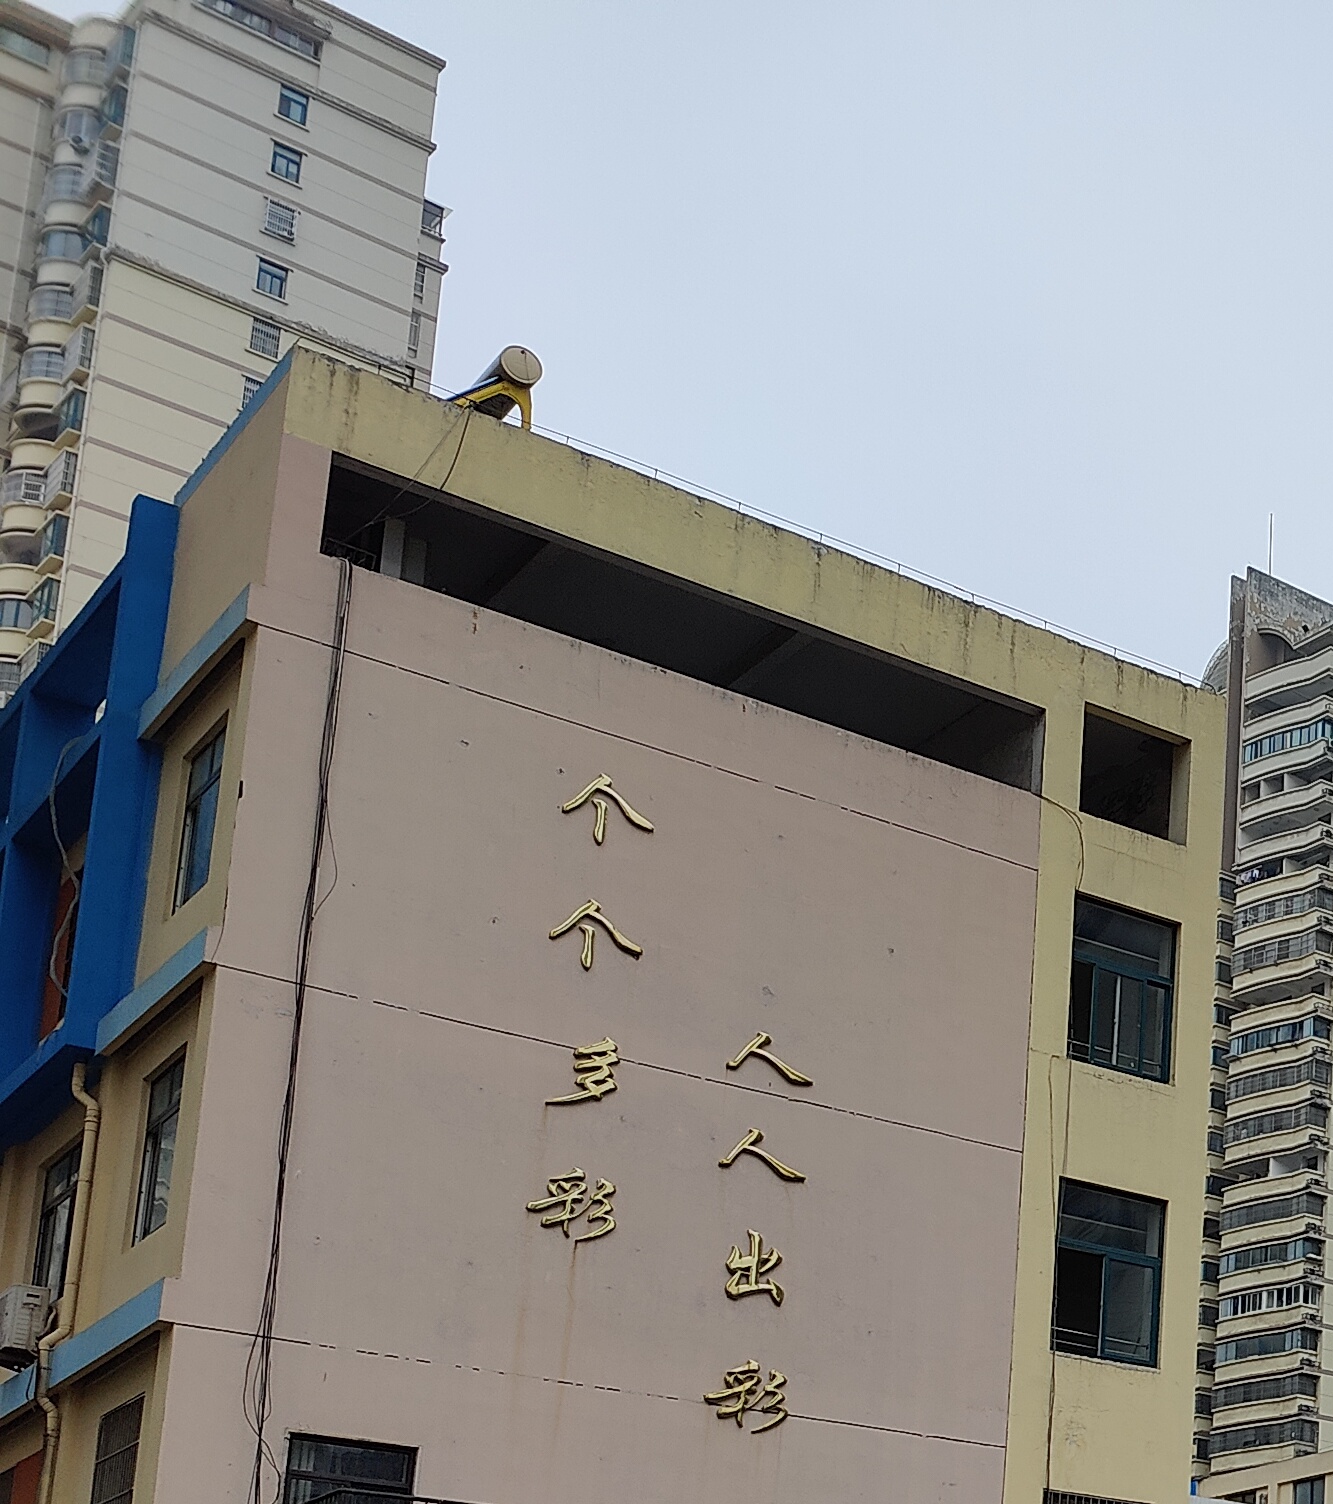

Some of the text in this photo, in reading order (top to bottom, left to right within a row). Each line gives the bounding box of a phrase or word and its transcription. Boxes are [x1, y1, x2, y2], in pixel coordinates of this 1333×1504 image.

[526, 773, 654, 1243] 个个多彩
[703, 1031, 813, 1434] 人人出彩
